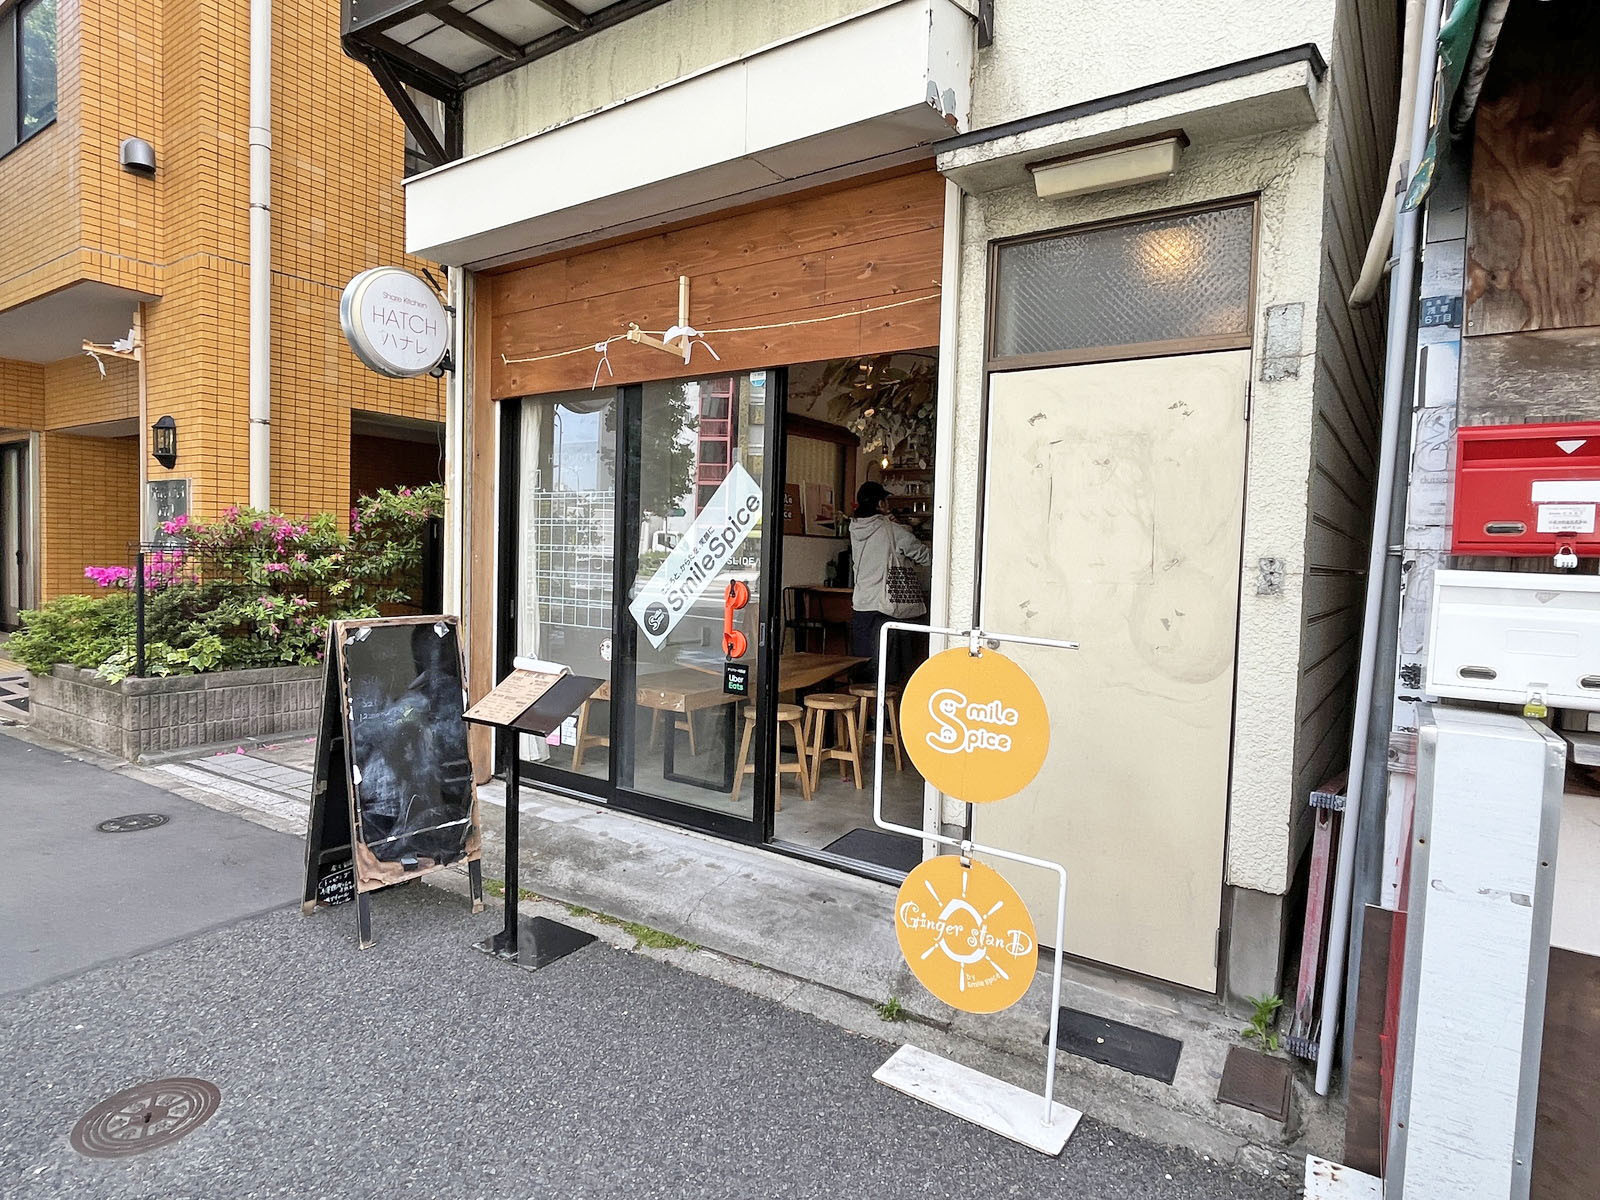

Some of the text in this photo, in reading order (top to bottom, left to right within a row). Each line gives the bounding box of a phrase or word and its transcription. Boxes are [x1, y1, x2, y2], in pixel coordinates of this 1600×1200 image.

[372, 305, 437, 336] HATCH
[383, 333, 427, 354] ハナレ
[667, 494, 760, 612] SmileSpice
[728, 674, 744, 683] Uber
[728, 682, 744, 691] Eats
[926, 688, 1018, 754] Smile
[900, 901, 964, 941] Ginger
